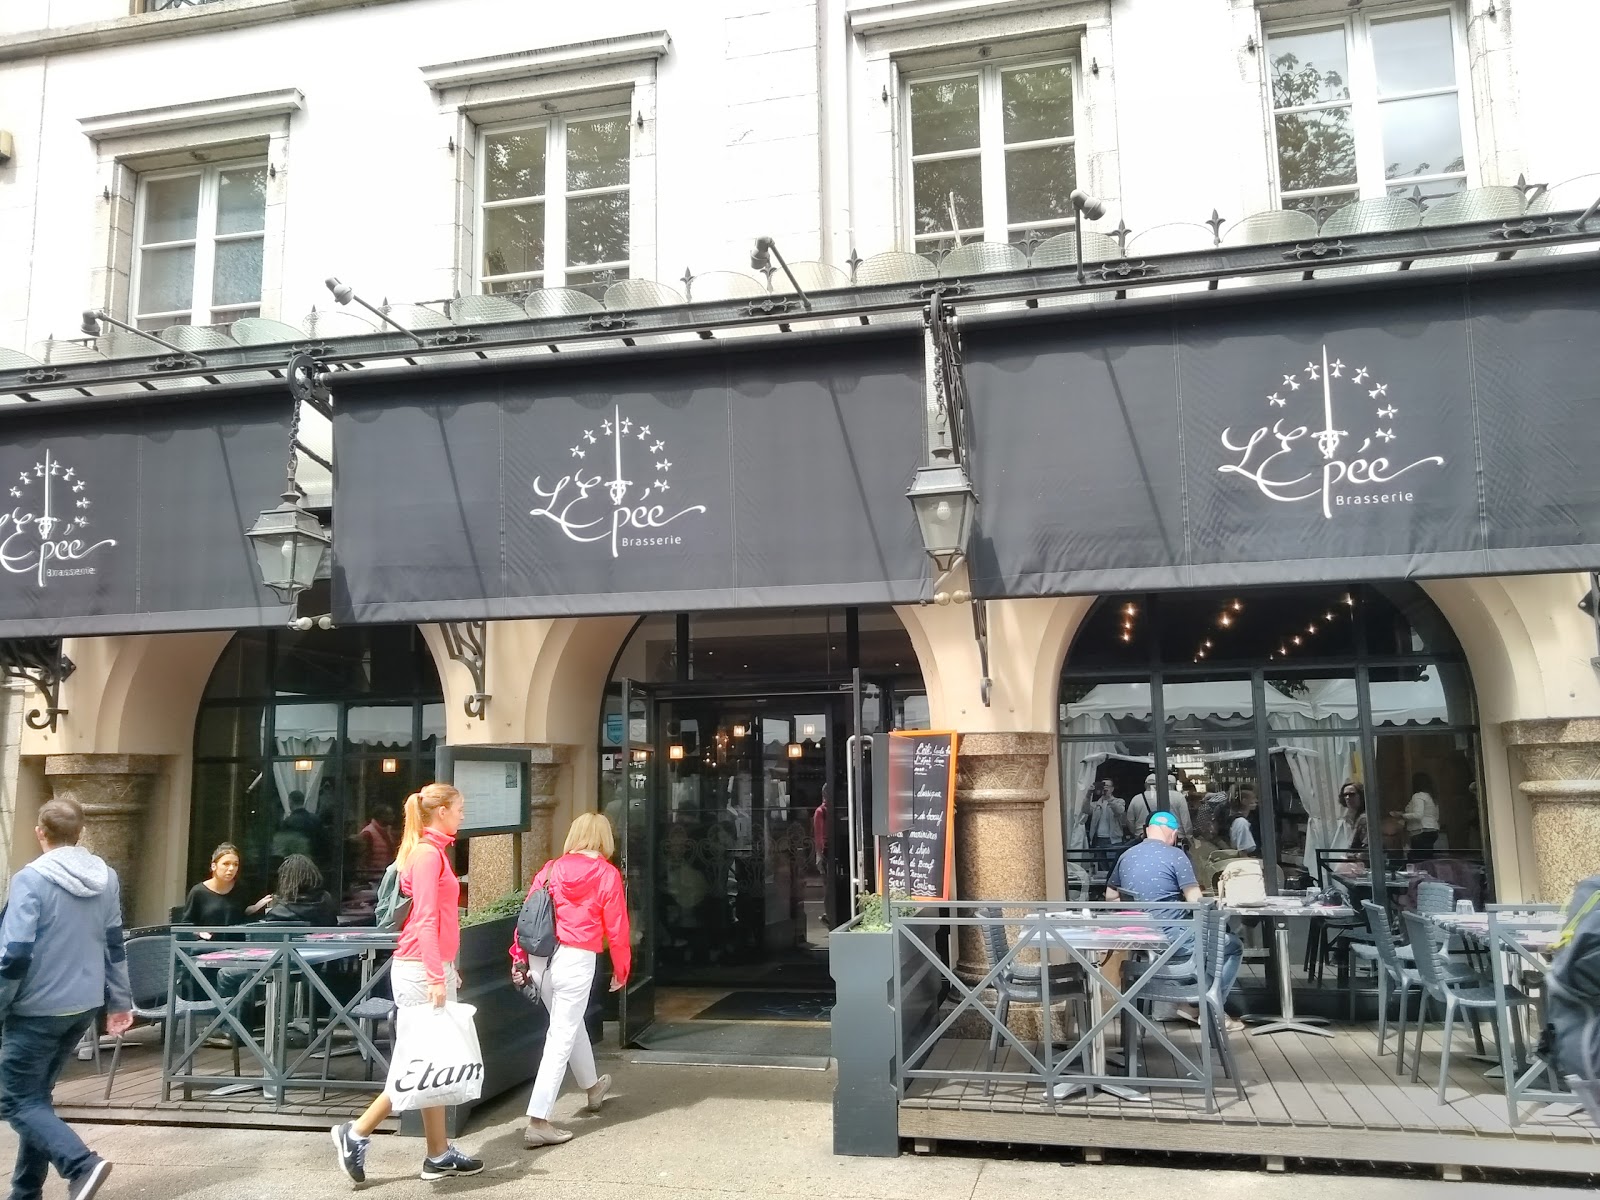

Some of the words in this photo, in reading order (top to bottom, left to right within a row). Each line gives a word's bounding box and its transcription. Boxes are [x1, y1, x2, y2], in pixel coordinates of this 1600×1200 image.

[1336, 491, 1414, 506] Brasserie
[621, 535, 682, 547] Brasserie
[47, 567, 96, 577] Brasserie
[395, 1059, 483, 1093] Etam
